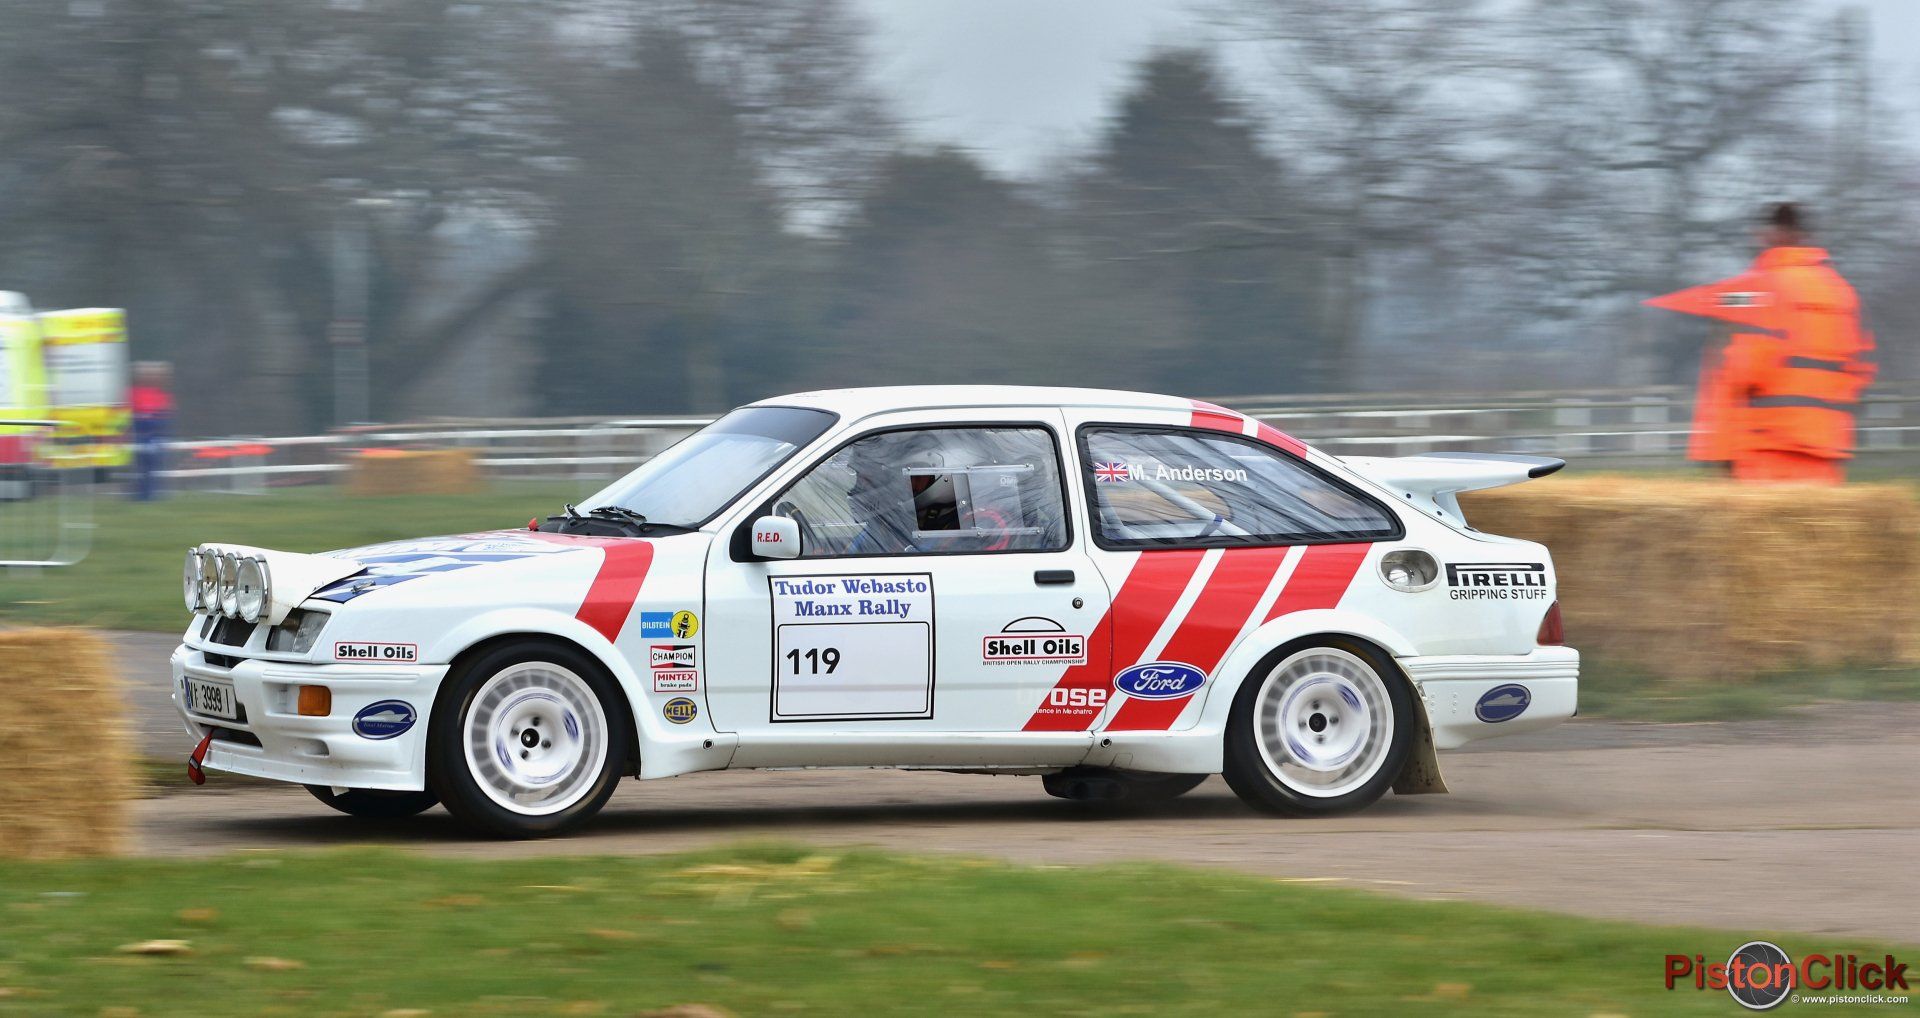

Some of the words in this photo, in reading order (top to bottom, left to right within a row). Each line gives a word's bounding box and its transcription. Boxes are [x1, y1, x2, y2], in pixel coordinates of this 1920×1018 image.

[1156, 464, 1248, 482] Anderson
[757, 532, 782, 543] R.E.D.
[1445, 563, 1546, 587] PIRELLI
[775, 580, 835, 596] Tudor
[841, 578, 927, 594] Webasto
[1450, 589, 1508, 600] GRIPPING
[1511, 589, 1547, 600] STUFF
[794, 600, 852, 617] Manx
[858, 599, 911, 618] Rally
[642, 621, 671, 629] BILSTEIN
[338, 645, 378, 659] Shell
[383, 646, 414, 660] Oils
[987, 639, 1036, 656] Shell
[1043, 638, 1080, 655] Oils
[652, 652, 693, 661] CHAMPION
[786, 648, 841, 675] 119
[657, 673, 694, 681] MINTEX
[1134, 668, 1187, 691] Ford
